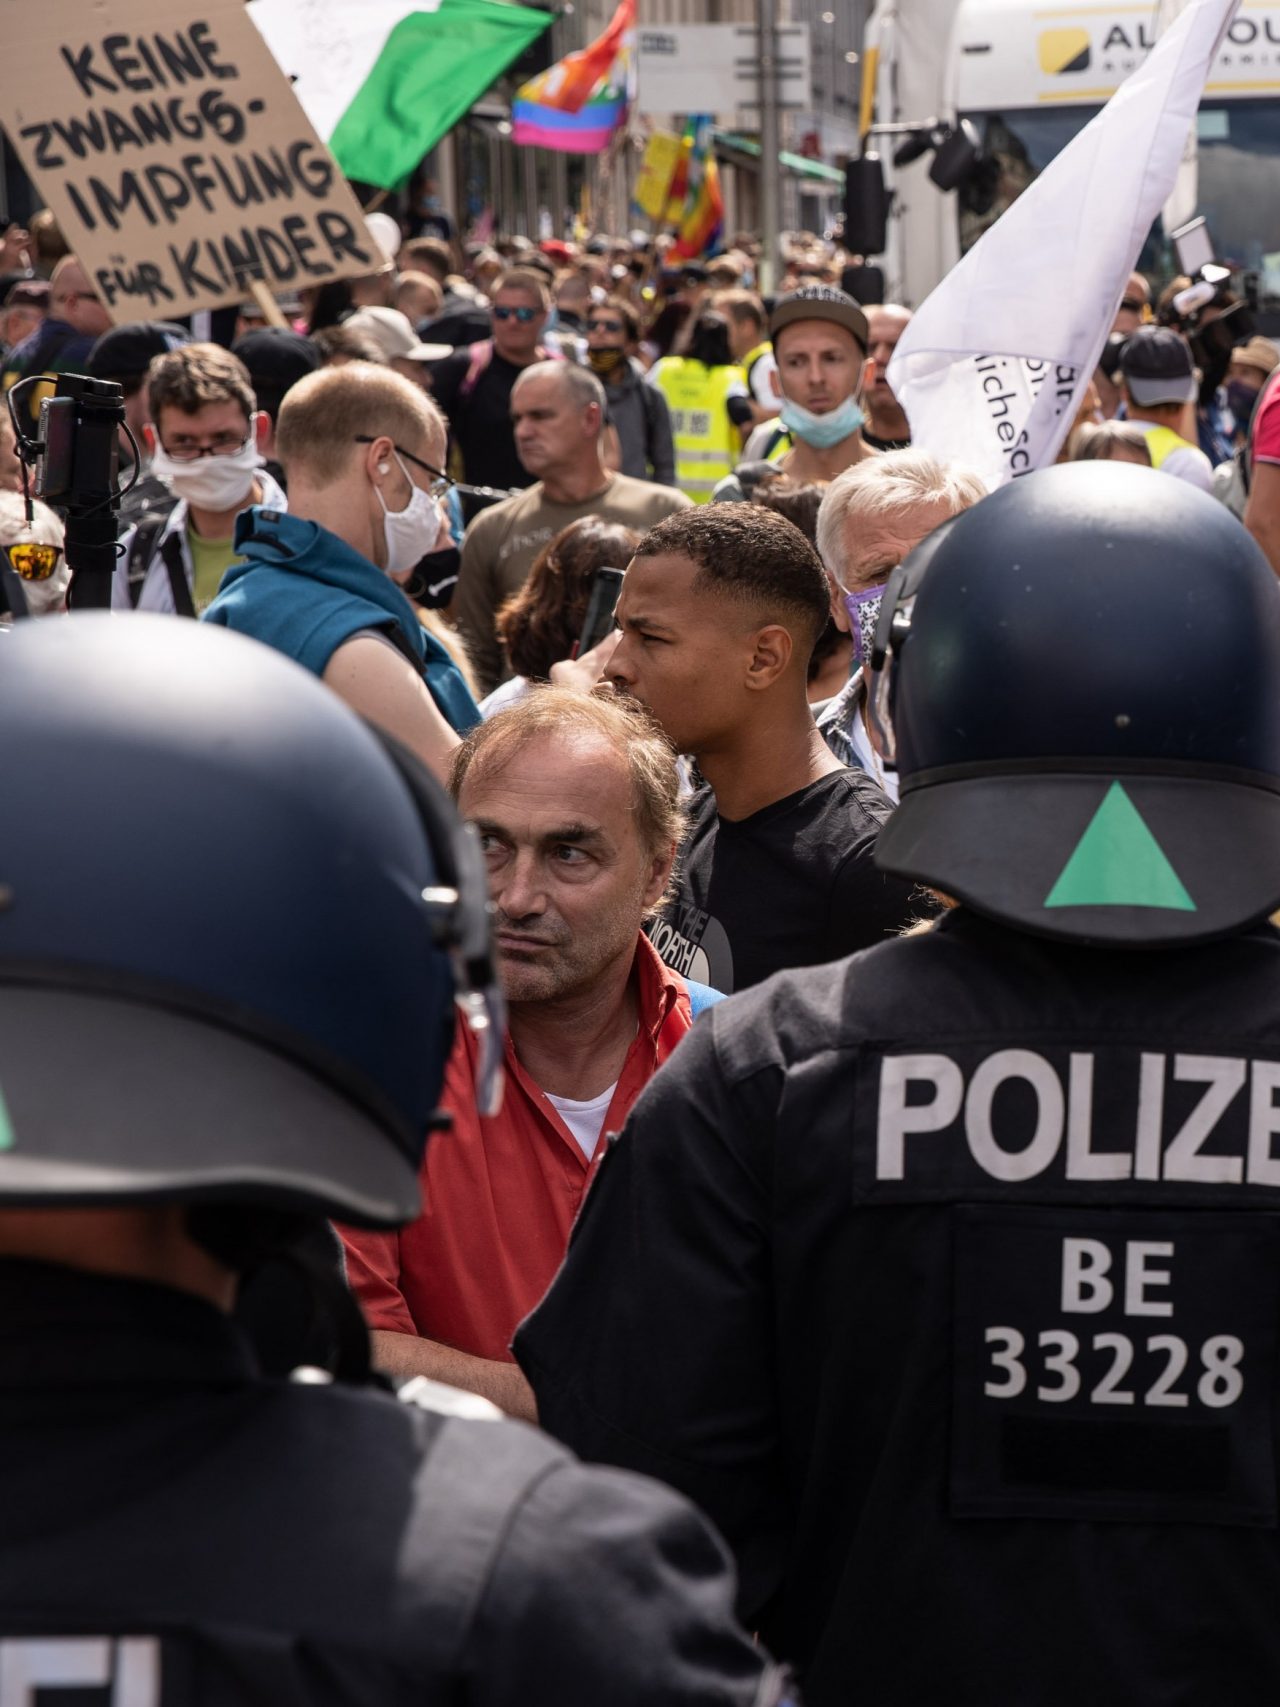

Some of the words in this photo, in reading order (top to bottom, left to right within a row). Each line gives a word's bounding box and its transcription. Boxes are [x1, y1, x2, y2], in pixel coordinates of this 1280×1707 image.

[60, 21, 239, 98] KEINE
[66, 141, 333, 232] IMPFUNG
[97, 254, 174, 306] FÜR
[169, 211, 372, 298] KINDER
[648, 918, 698, 977] NORTH
[1061, 1238, 1174, 1317] BE
[984, 1326, 1245, 1408] 33228
